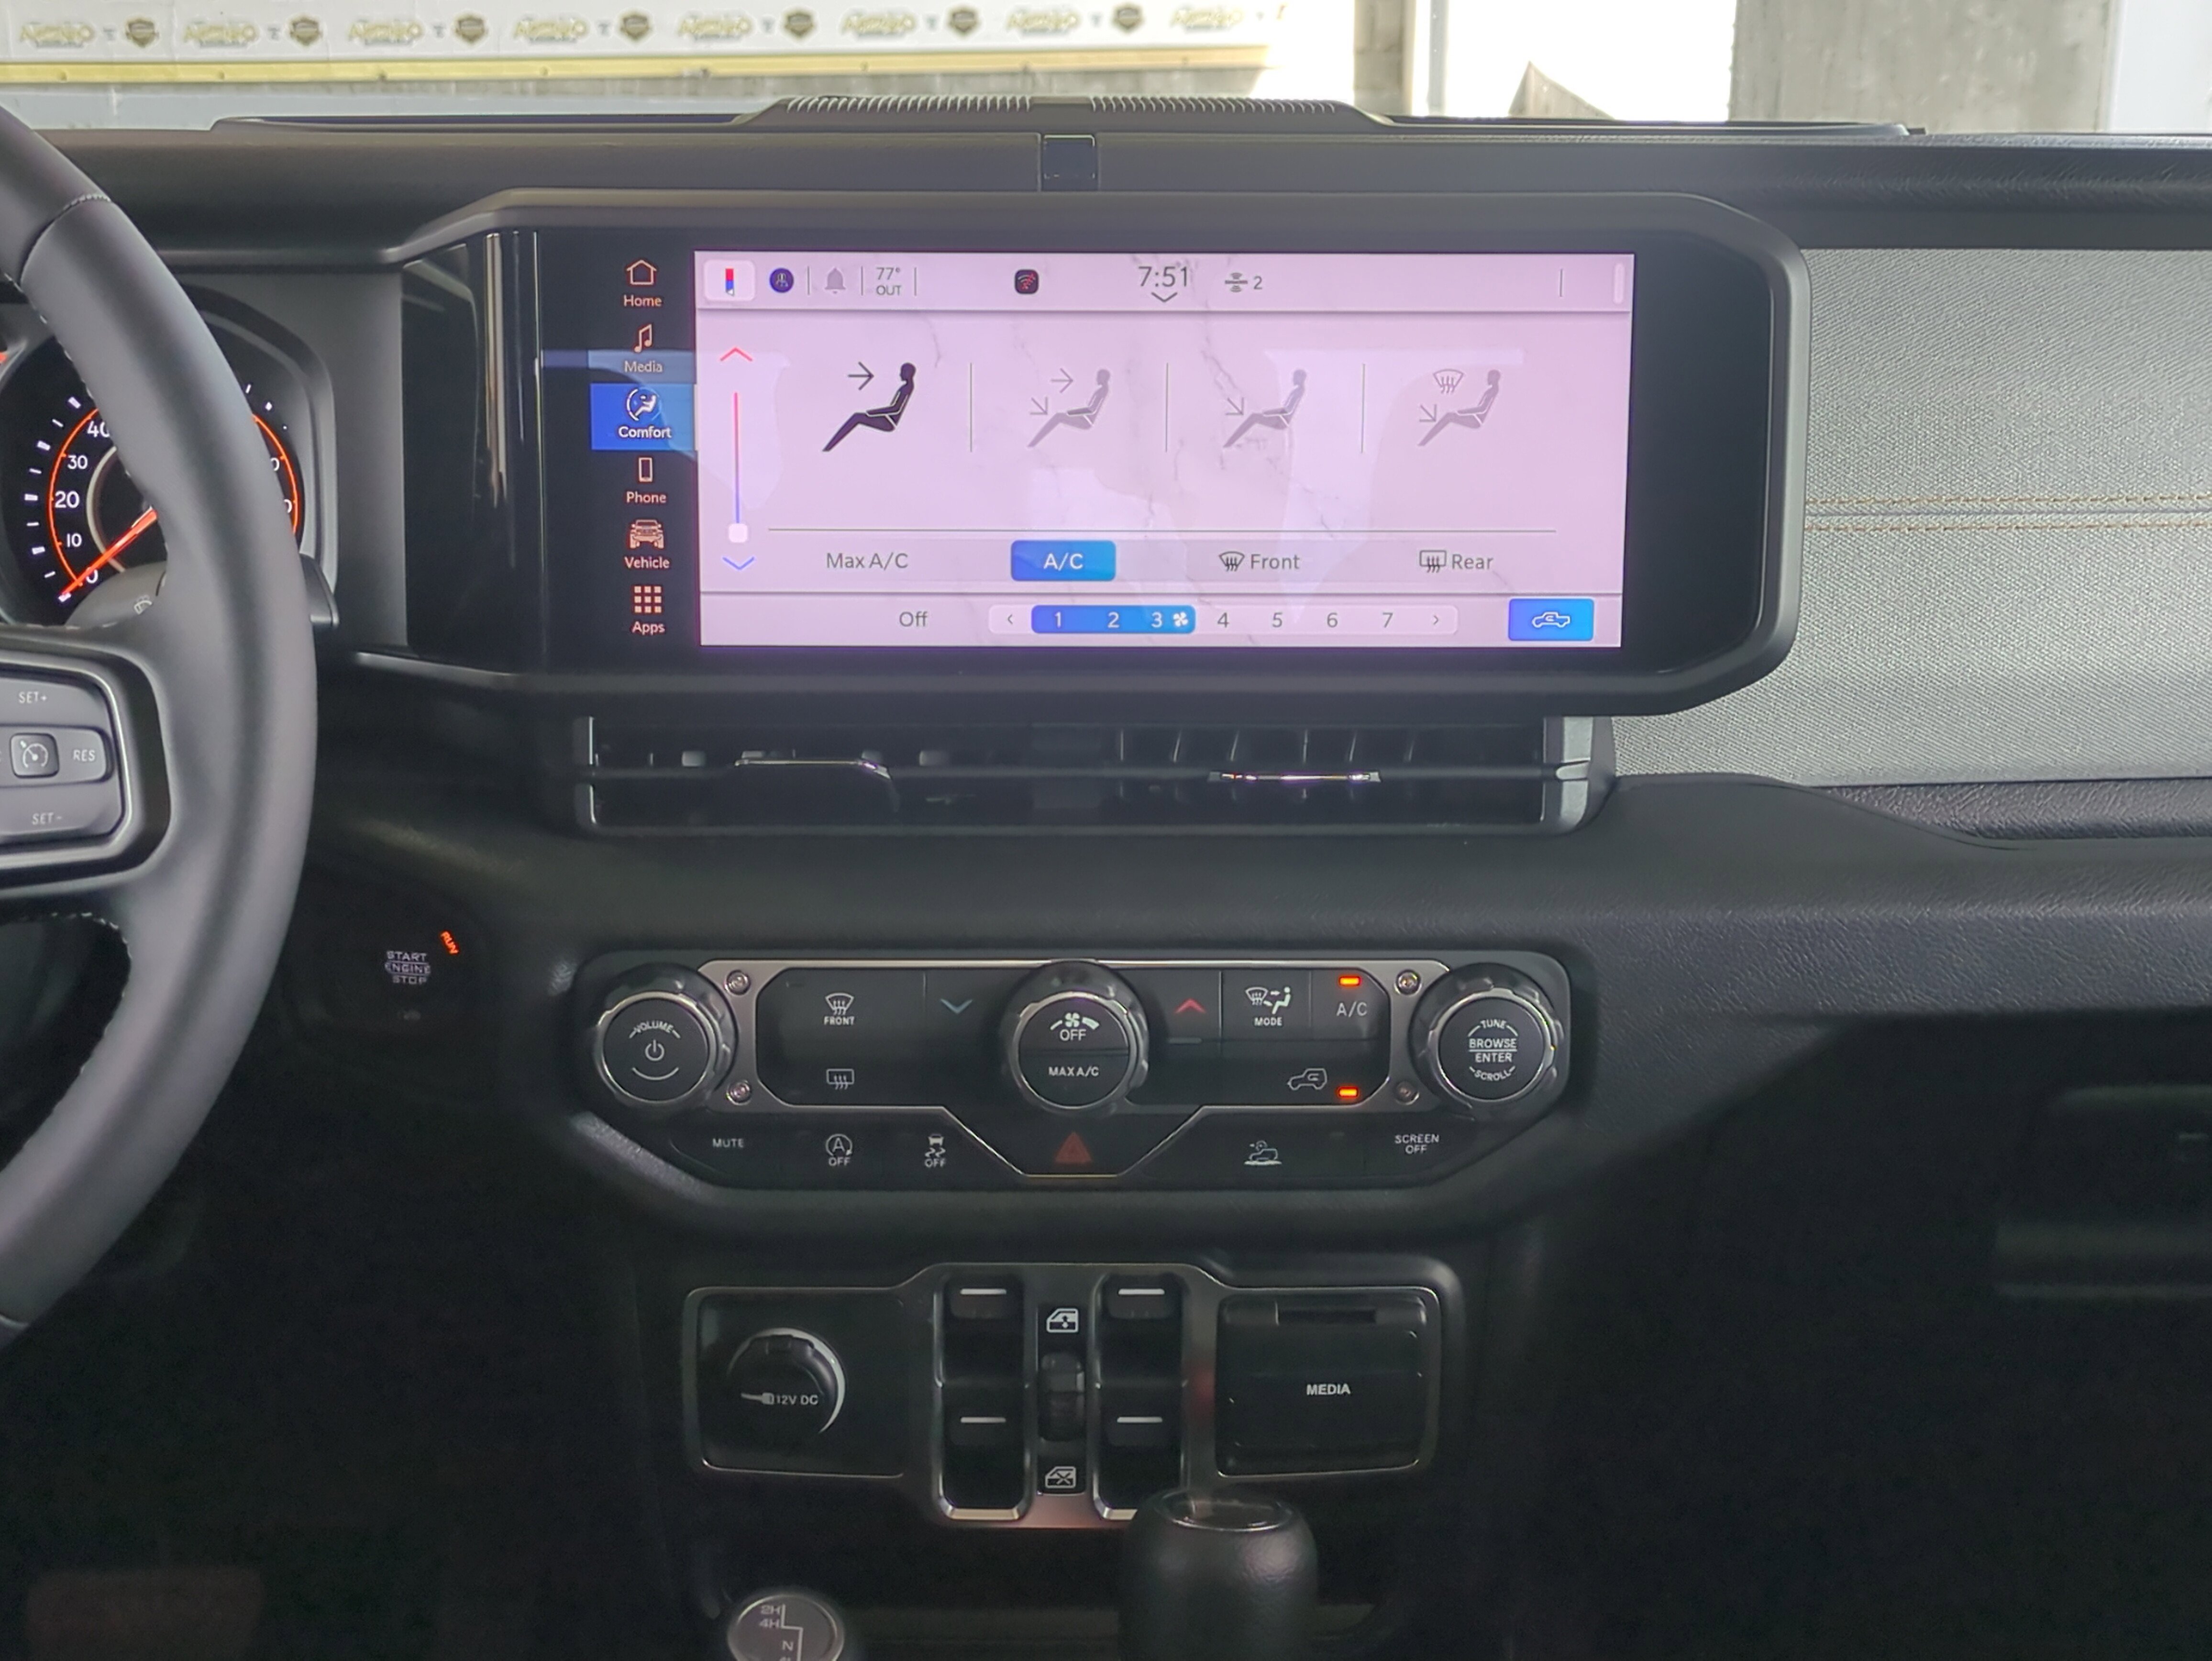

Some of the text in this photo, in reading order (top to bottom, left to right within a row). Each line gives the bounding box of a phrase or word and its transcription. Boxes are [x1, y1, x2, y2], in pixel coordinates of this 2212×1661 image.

[876, 267, 900, 280] 77°
[1138, 266, 1188, 287] 7:51
[1253, 276, 1262, 290] 2
[876, 285, 901, 296] OUT
[624, 295, 662, 307] Home
[624, 361, 663, 373] Media
[618, 426, 672, 438] Comfort
[67, 455, 88, 469] 30
[55, 491, 79, 508] 20
[626, 492, 666, 504] Phone
[66, 533, 82, 547] 10
[624, 557, 670, 569] Vehicle
[826, 553, 908, 569] Max A/C
[1043, 553, 1084, 570] A/C
[1250, 554, 1300, 570] Front
[1452, 554, 1493, 570] Rear
[899, 611, 928, 627] Off
[1054, 612, 1394, 628] 1 2 3 4 5 6 7
[632, 621, 665, 634] Apps
[19, 692, 47, 703] SET+
[73, 749, 95, 761] RES
[440, 931, 459, 954] RUN
[387, 951, 427, 961] START
[385, 963, 430, 973] ENGINE
[392, 975, 427, 985] STOP
[1337, 1002, 1367, 1017] A/C
[824, 1016, 854, 1025] FRONT
[1254, 1018, 1283, 1027] MODE
[1481, 1020, 1507, 1029] TUNE
[634, 1020, 674, 1034] VOLUME
[1060, 1029, 1086, 1041] OFF
[1469, 1038, 1516, 1049] BROWSE
[1475, 1053, 1513, 1063] ENTER
[1049, 1066, 1099, 1077] MAX A/C
[1474, 1069, 1511, 1081] SCROLL
[712, 1139, 744, 1148] MUTE
[1395, 1134, 1439, 1144] SCREEN
[1405, 1145, 1427, 1154] OFF
[828, 1157, 851, 1166] OFF
[924, 1157, 945, 1167] OFF
[1306, 1384, 1350, 1396] MEDIA
[776, 1395, 818, 1406] 12V DC
[761, 1605, 781, 1615] 2H
[759, 1619, 780, 1628] 4H
[782, 1640, 794, 1651] N
